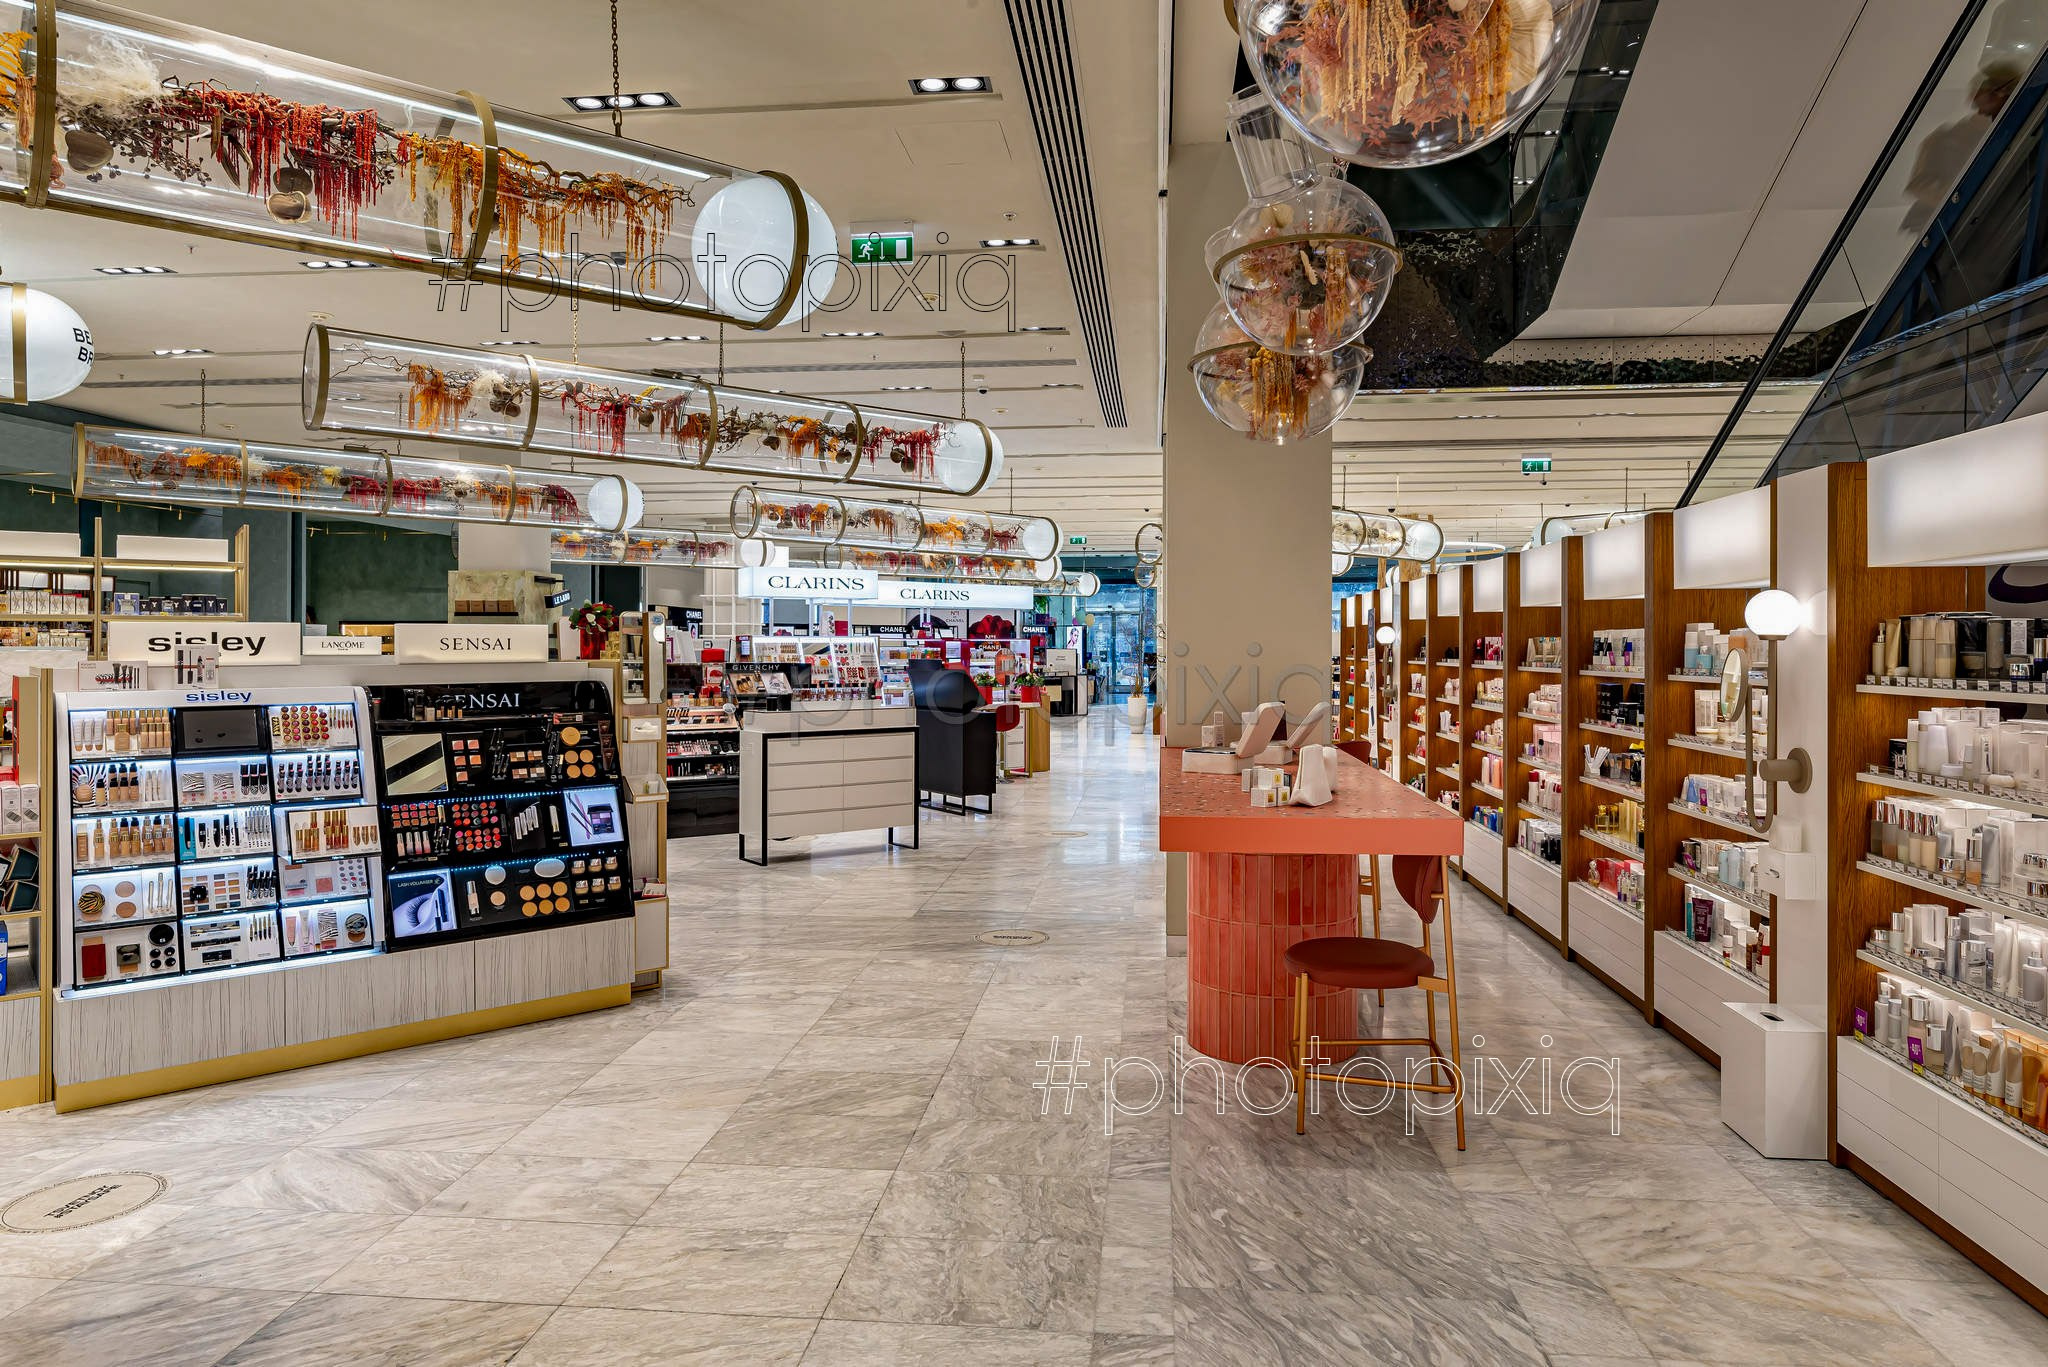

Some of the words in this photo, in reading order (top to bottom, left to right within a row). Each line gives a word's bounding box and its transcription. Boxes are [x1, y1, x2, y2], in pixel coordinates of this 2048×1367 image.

[768, 575, 865, 591] CLARINS
[900, 588, 970, 601] CLARINS
[686, 610, 703, 620] CHANEL
[148, 632, 266, 656] sisley
[321, 641, 365, 649] LANCÔME
[439, 637, 512, 651] SENSAI
[185, 690, 252, 703] sisley
